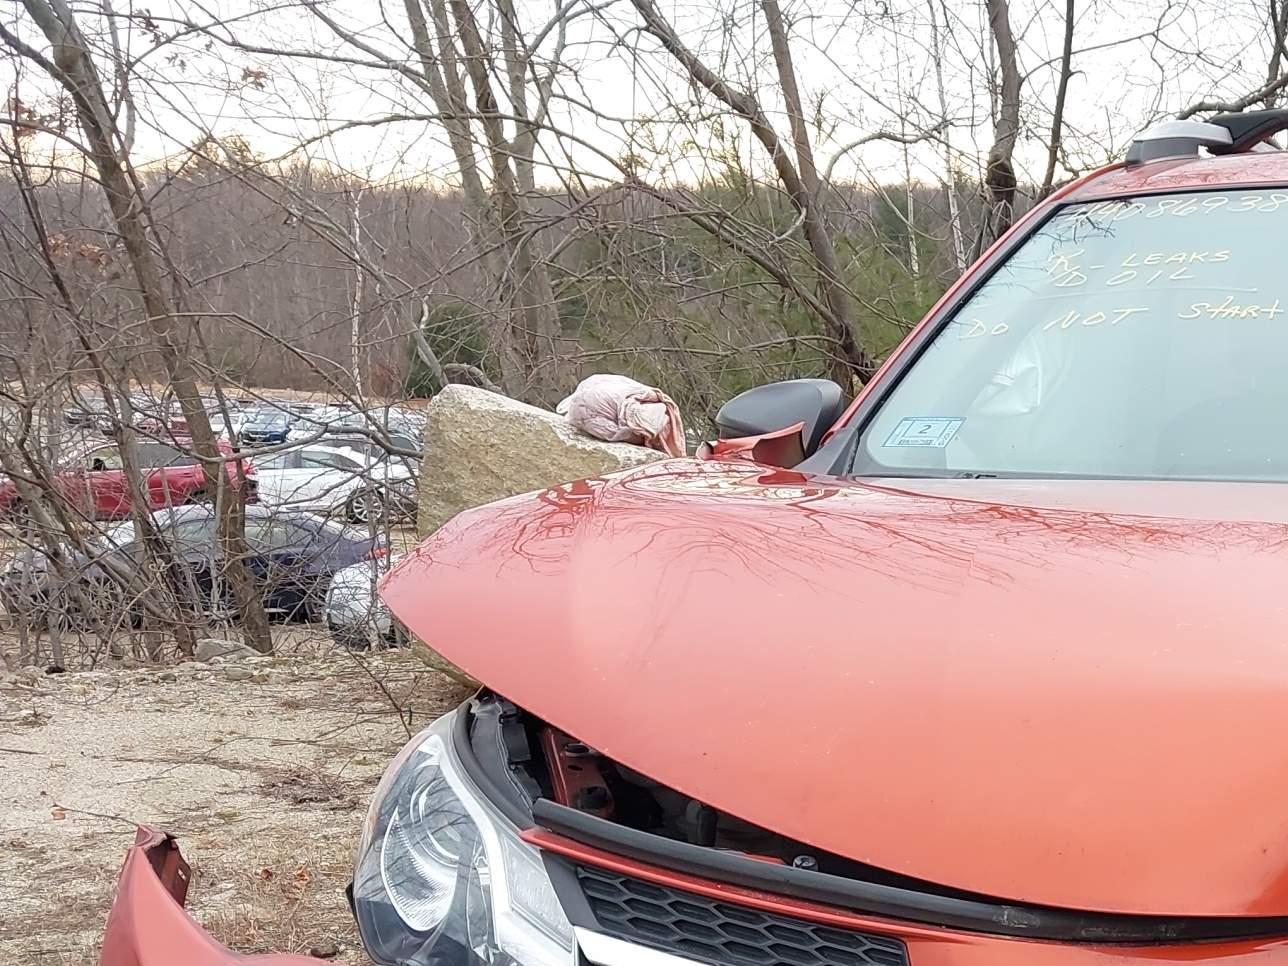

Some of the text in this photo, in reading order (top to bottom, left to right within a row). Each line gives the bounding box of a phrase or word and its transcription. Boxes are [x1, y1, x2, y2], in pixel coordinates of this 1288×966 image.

[1122, 250, 1231, 267] LEAKS
[1106, 267, 1195, 287] OIL
[958, 319, 1009, 339] DO
[1042, 307, 1150, 332] NOT
[918, 425, 932, 434] 2
